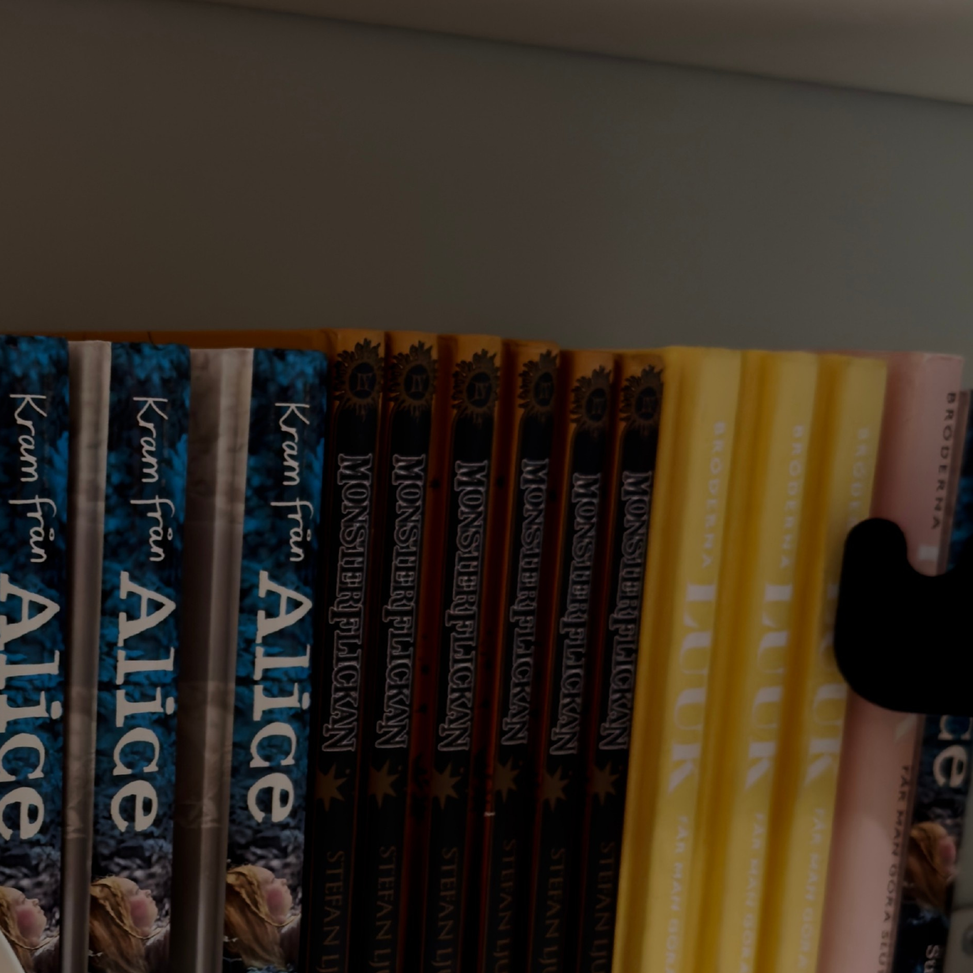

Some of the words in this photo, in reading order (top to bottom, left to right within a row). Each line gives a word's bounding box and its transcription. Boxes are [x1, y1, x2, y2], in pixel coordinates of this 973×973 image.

[9, 394, 47, 483] Kram
[133, 396, 168, 483] Kram
[274, 403, 310, 485] Kram
[8, 495, 57, 563] från
[129, 495, 173, 562] från
[269, 498, 313, 562] från
[110, 570, 177, 832] Alice
[247, 570, 313, 823] Alice
[667, 583, 718, 797] LUUK
[744, 583, 793, 790] LUUK
[892, 809, 904, 856] MAN
[323, 850, 346, 947] STEFAN
[375, 845, 397, 940] STEFAN
[437, 847, 458, 940] STEFAN
[497, 839, 517, 930] STEFAN
[545, 848, 566, 939] STEFAN
[594, 841, 615, 934] STEFAN
